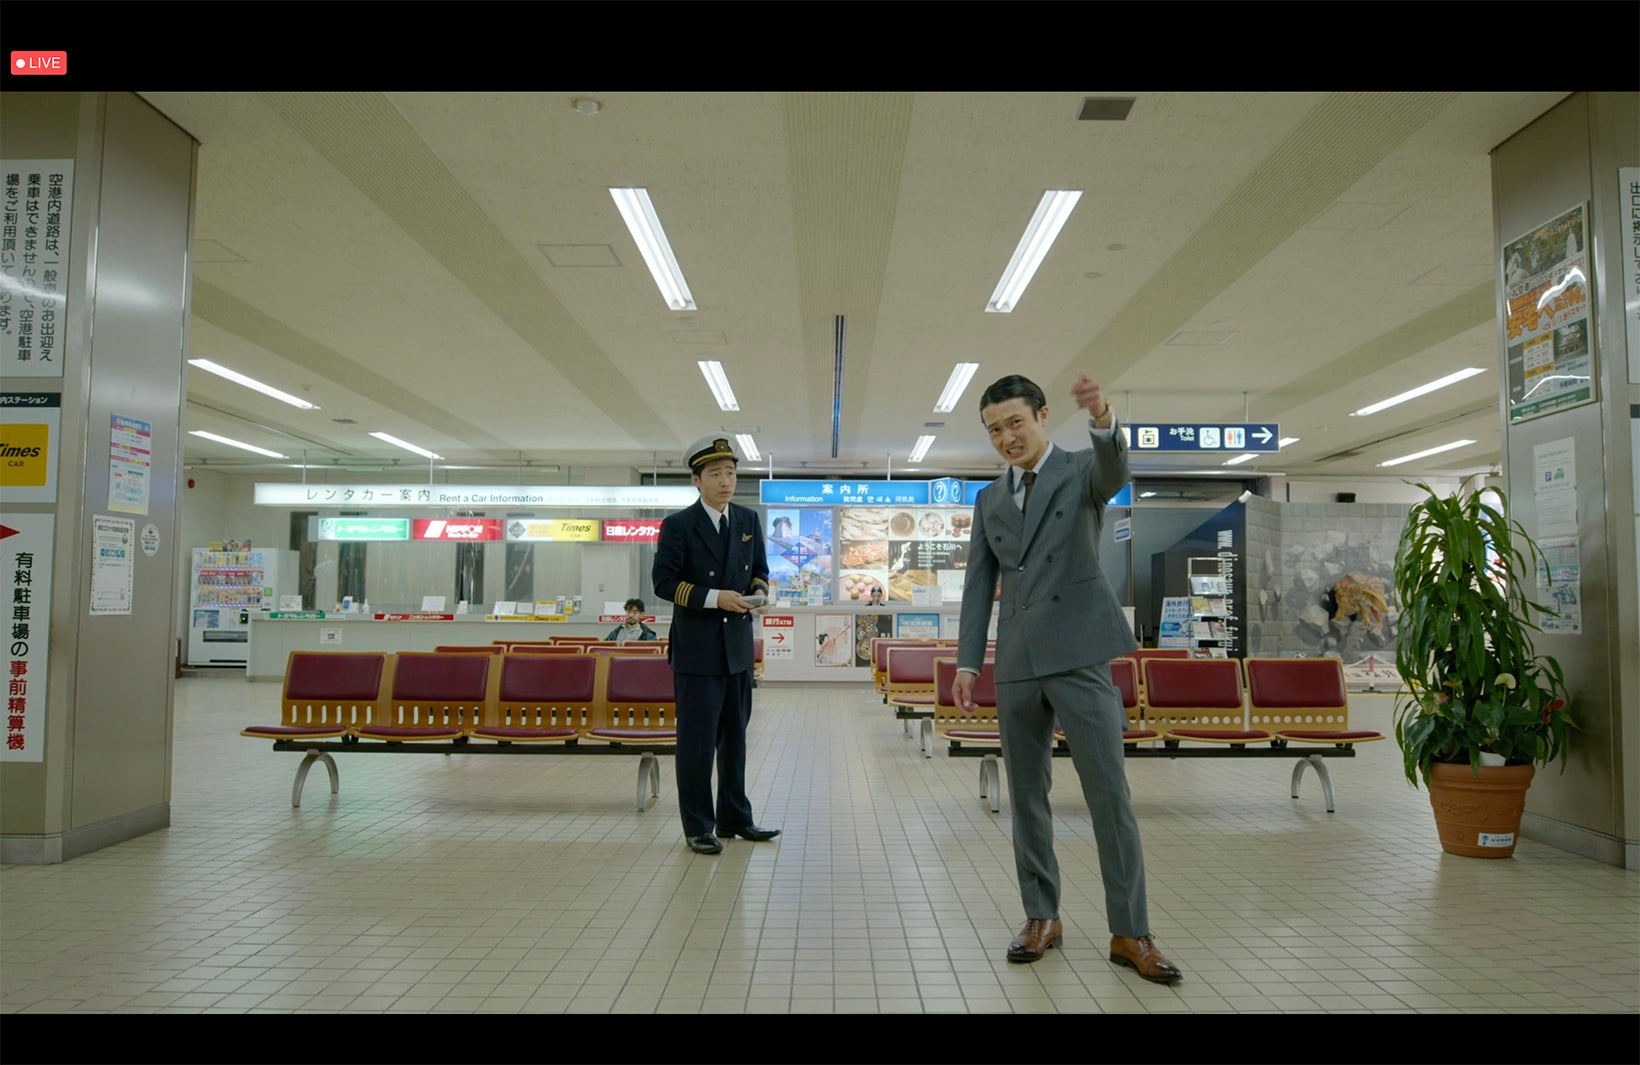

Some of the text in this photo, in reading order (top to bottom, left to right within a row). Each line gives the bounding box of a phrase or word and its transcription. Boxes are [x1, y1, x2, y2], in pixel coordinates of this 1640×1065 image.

[0, 173, 20, 336] 場をご利用頂いてります。
[1169, 427, 1195, 436] お手洗
[7, 460, 25, 468] CAR
[822, 484, 869, 494] 案内所
[306, 488, 431, 502] レンタカー案内
[439, 494, 460, 503] Rent
[472, 494, 487, 503] Car
[490, 494, 544, 503] Information
[784, 495, 824, 503] Information
[560, 522, 592, 532] Times
[917, 542, 963, 551] ようこそ石川へ
[764, 617, 792, 625] 銀行ATM
[6, 552, 34, 750] 有料駐車場の事前精算機
